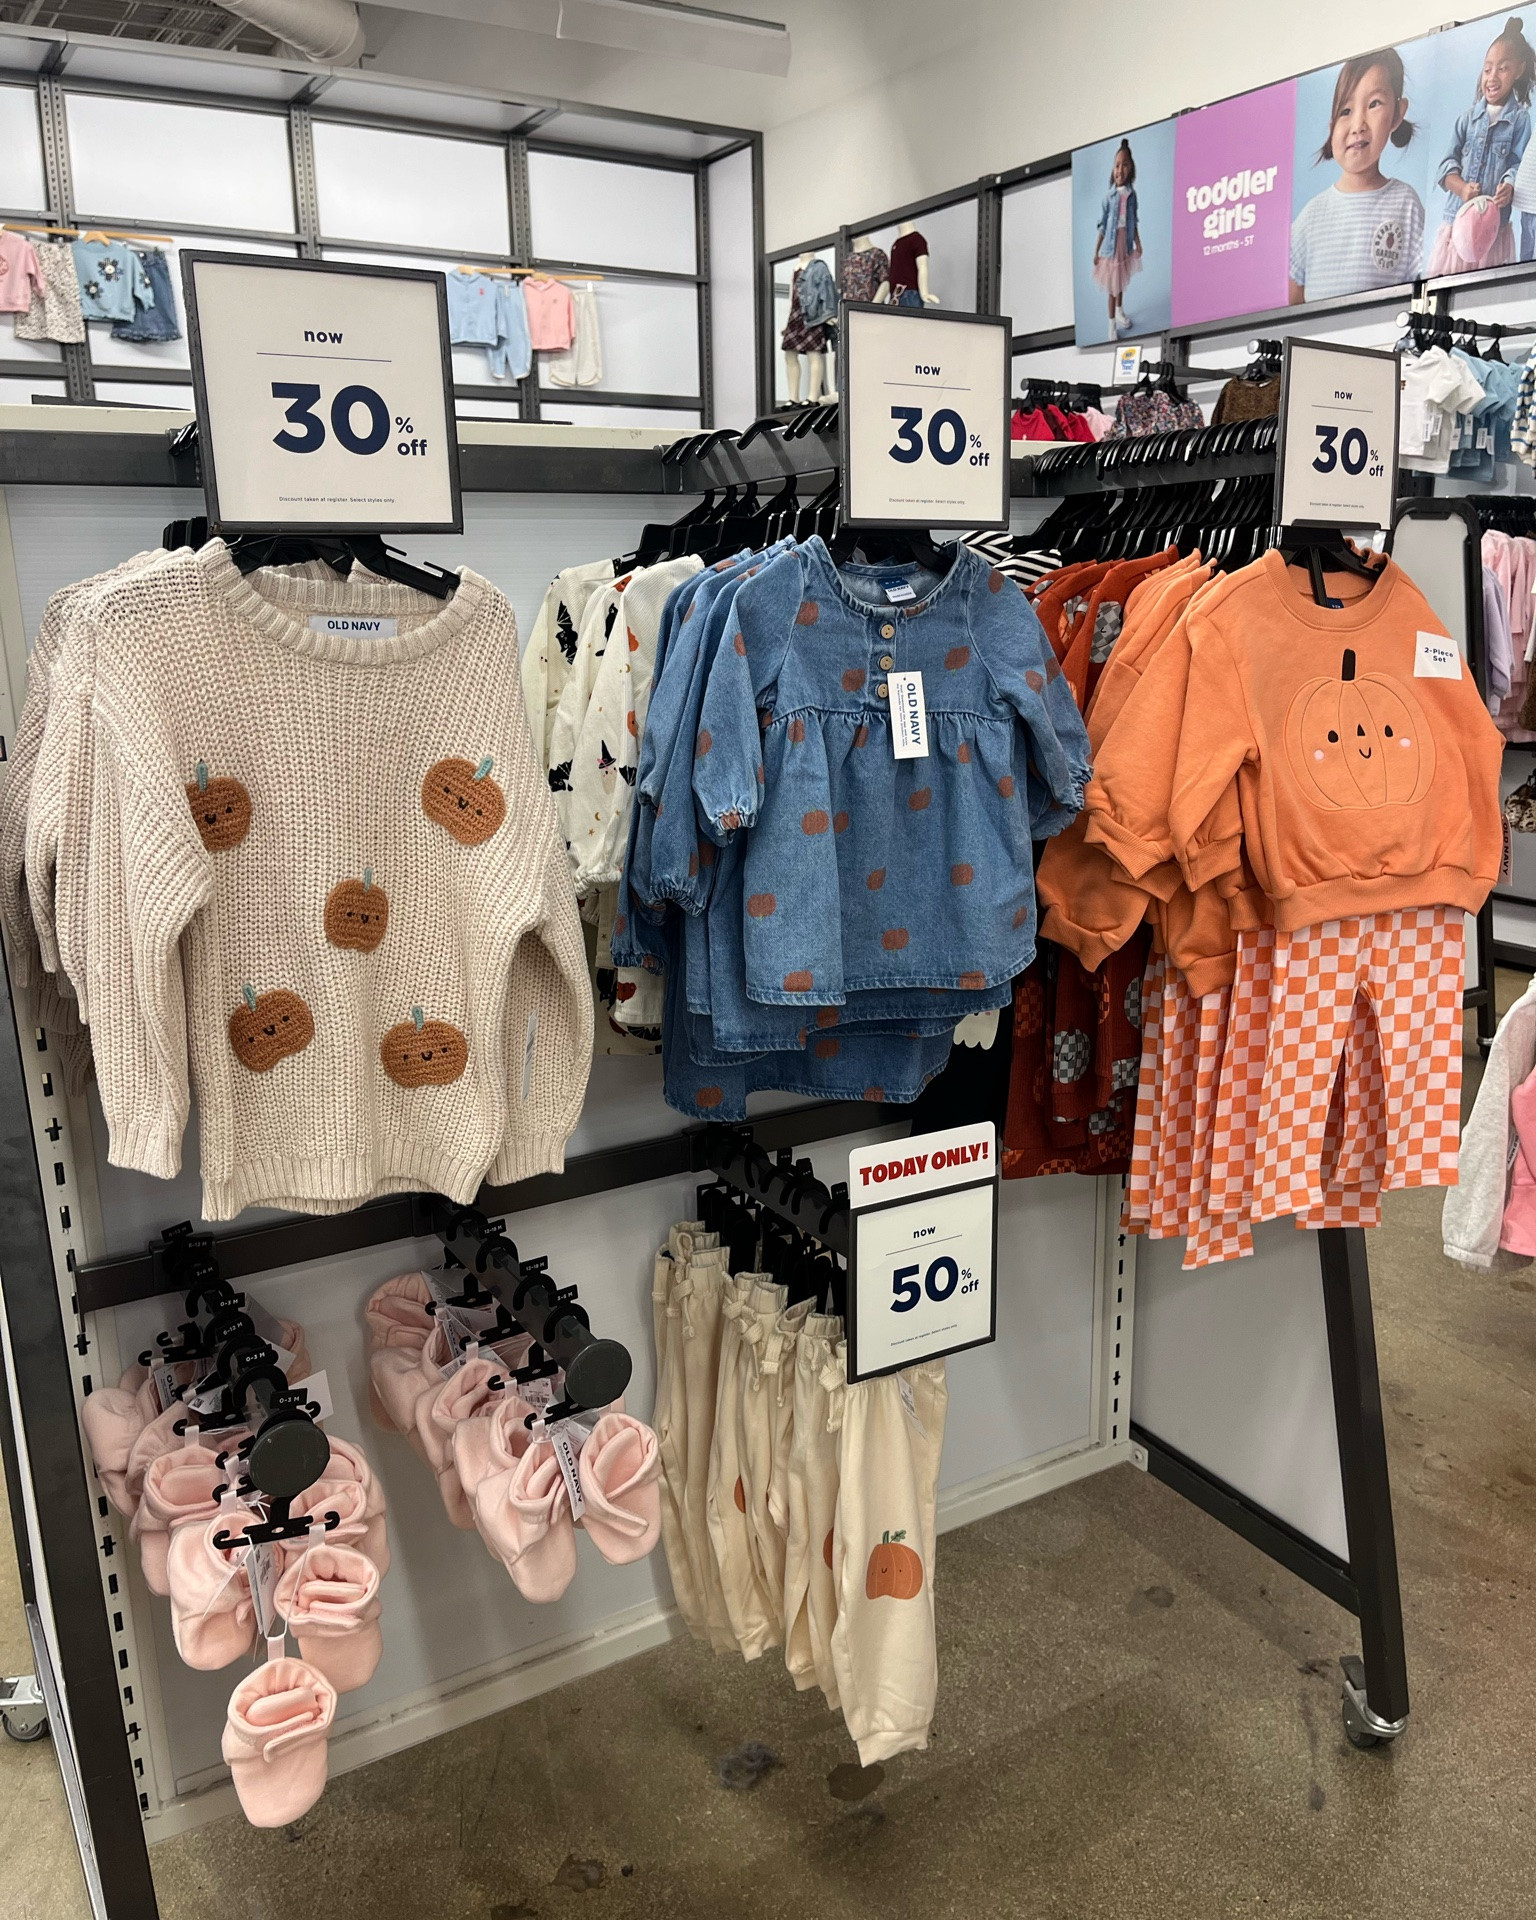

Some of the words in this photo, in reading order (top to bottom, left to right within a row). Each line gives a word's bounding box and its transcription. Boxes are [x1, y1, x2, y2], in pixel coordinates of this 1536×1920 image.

[1186, 165, 1277, 213] toddler
[1203, 203, 1256, 240] girls
[304, 330, 343, 344] now
[915, 364, 941, 376] now
[1334, 390, 1353, 400] now
[271, 382, 391, 455] 30
[888, 406, 967, 465] 30
[397, 439, 428, 456] off
[1312, 425, 1369, 475] 30
[969, 453, 990, 466] off
[1369, 465, 1384, 477] off
[327, 620, 349, 630] OLD
[352, 621, 381, 631] NAVY
[1424, 647, 1453, 658] 2-Piece
[1433, 655, 1446, 663] Set
[907, 683, 918, 708] OLD
[909, 709, 921, 745] NAVY
[859, 1154, 928, 1186] TODAY
[931, 1141, 989, 1171] ONLY!
[913, 1226, 936, 1238] now
[890, 1256, 959, 1313] 50
[961, 1279, 979, 1294] off
[220, 1299, 232, 1307] 0-3
[223, 1325, 236, 1336] 6-12
[245, 1354, 258, 1362] 0-3
[166, 1374, 176, 1398] OLD
[279, 1396, 292, 1404] 0-3
[562, 1441, 573, 1466] OLD
[571, 1467, 583, 1504] NAVY
